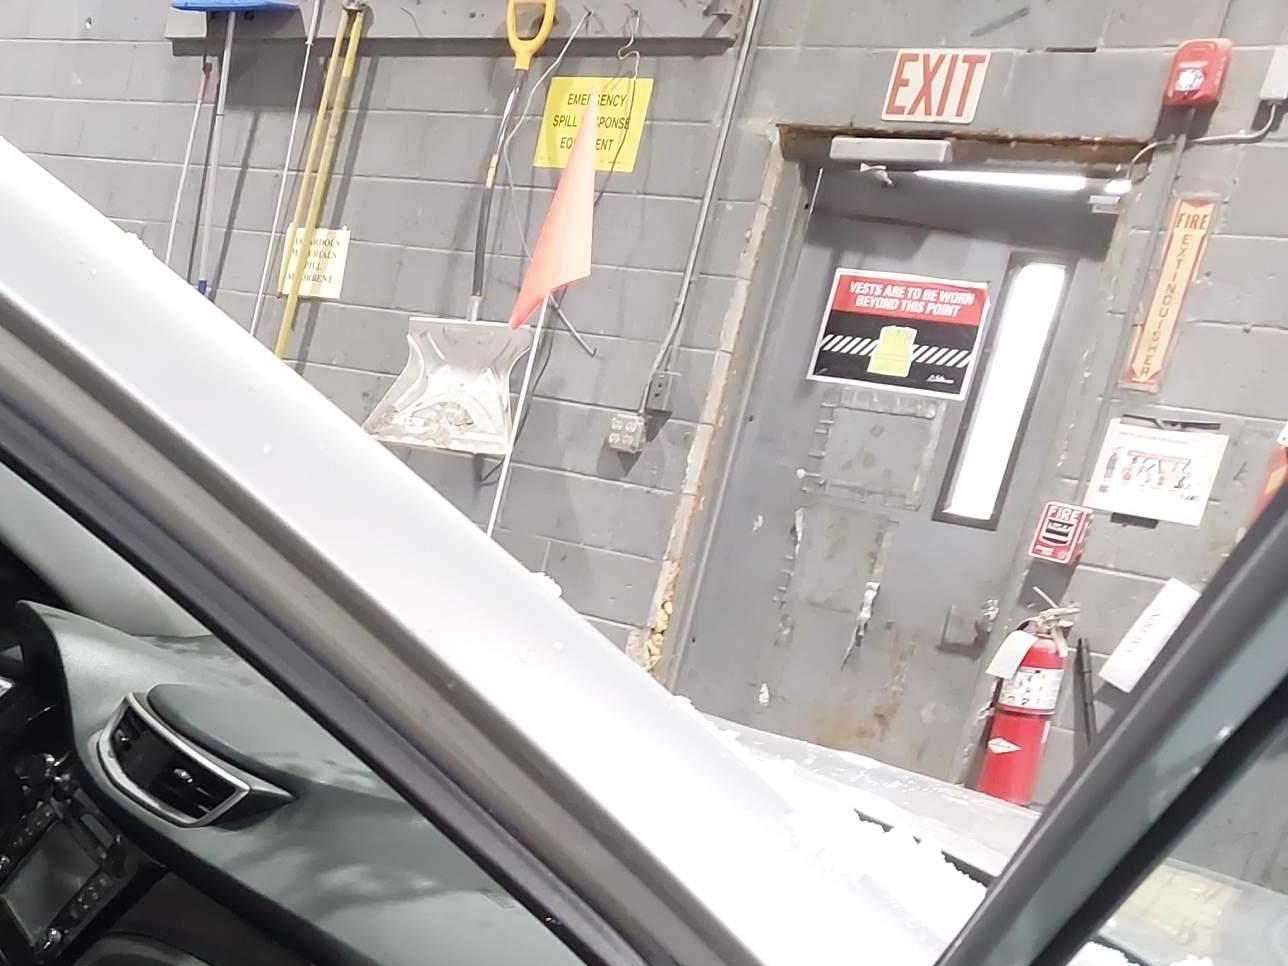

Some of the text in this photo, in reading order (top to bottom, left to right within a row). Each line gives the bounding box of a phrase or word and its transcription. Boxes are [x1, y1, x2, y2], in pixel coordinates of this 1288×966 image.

[886, 53, 987, 117] EXIT
[567, 93, 628, 107] EMEENCY
[552, 114, 630, 130] SPILL PONSE
[559, 136, 614, 151] EQENT
[1175, 212, 1210, 230] FIRE
[849, 281, 976, 305] VESTS ARE TO BE WORN
[856, 294, 961, 317] BEYOND THIS POINT
[1047, 505, 1081, 523] FIRE
